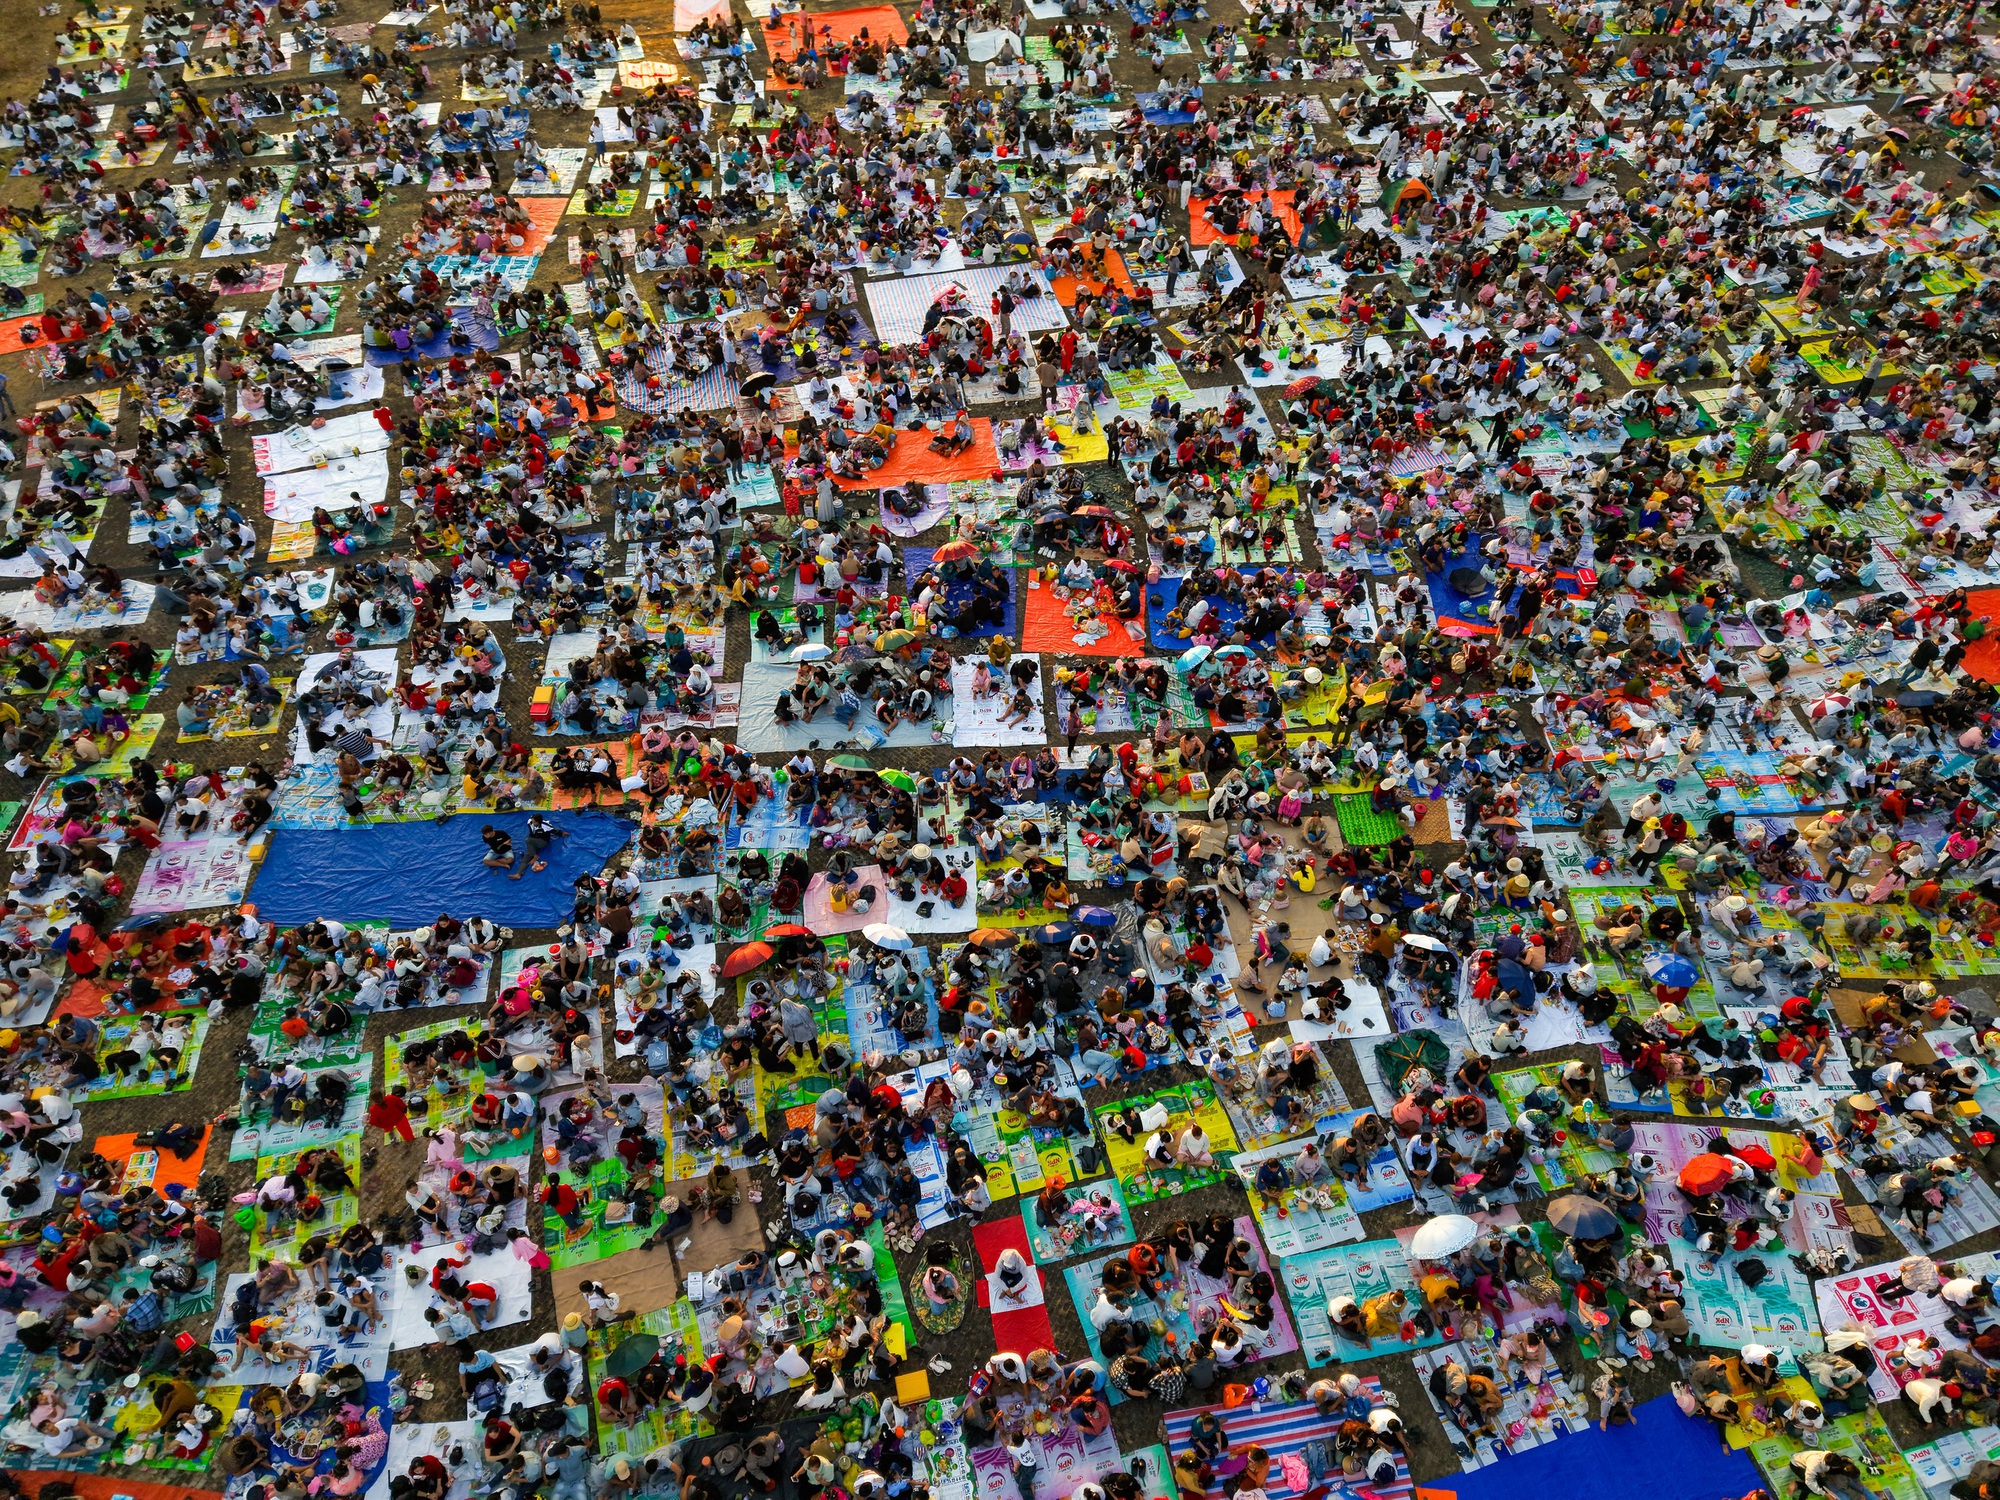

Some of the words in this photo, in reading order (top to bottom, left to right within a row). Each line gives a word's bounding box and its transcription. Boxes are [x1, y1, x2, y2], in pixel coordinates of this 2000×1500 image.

[1007, 1116, 1020, 1124] NPK
[308, 1121, 324, 1130] NPK
[1047, 1157, 1060, 1167] NPK
[989, 1171, 1002, 1180] NPK
[1383, 1169, 1395, 1178] NPK
[1357, 1263, 1371, 1273] NPK
[1294, 1276, 1307, 1284] NPK
[1779, 1323, 1794, 1331] NPK
[1912, 1449, 1930, 1459] NPK
[1057, 1459, 1072, 1470] NPK
[988, 1479, 1002, 1489] NPK
